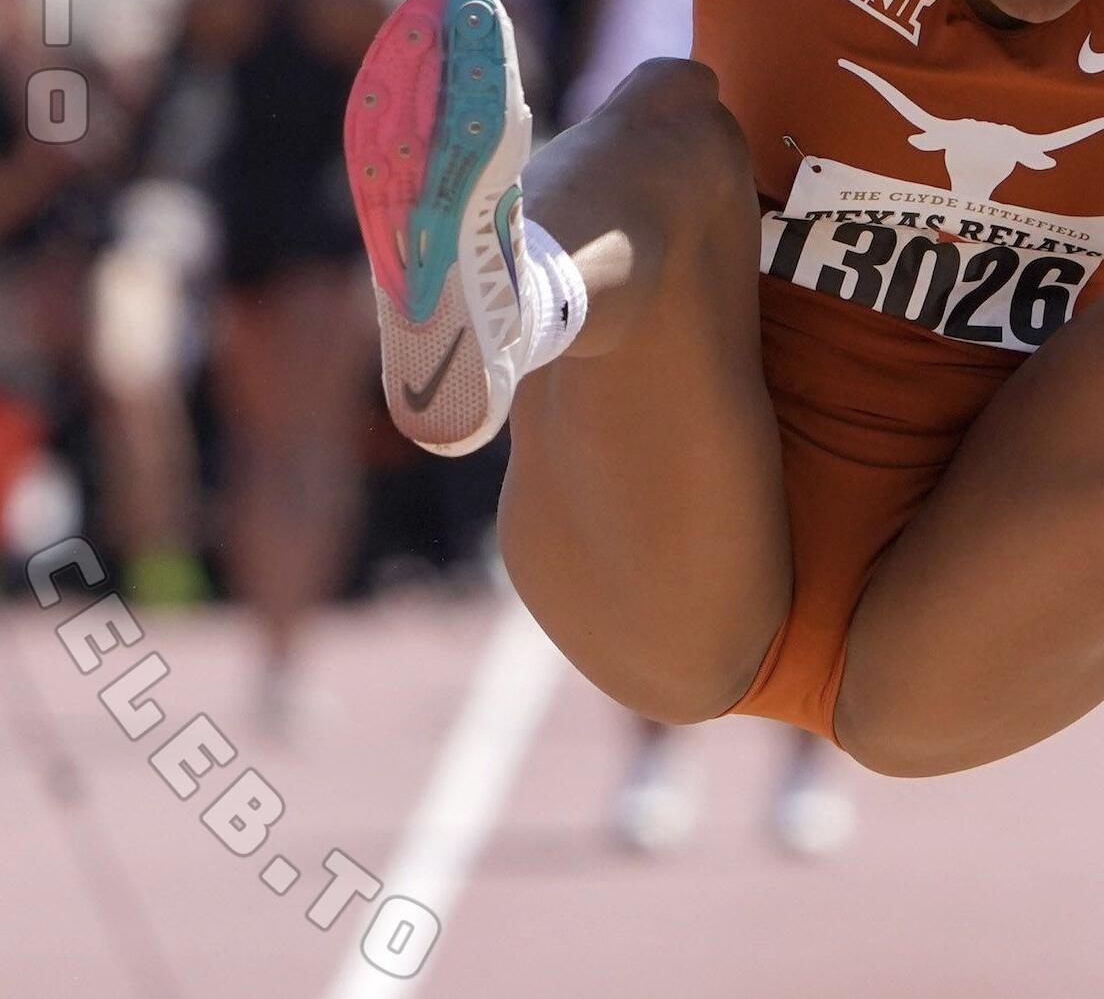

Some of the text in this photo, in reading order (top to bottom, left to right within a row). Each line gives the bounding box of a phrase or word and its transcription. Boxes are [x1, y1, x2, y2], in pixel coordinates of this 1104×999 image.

[840, 191, 1090, 241] THE CLYDE LITTLEFIELD
[957, 219, 1104, 257] RELAY
[772, 215, 1085, 347] 13026
